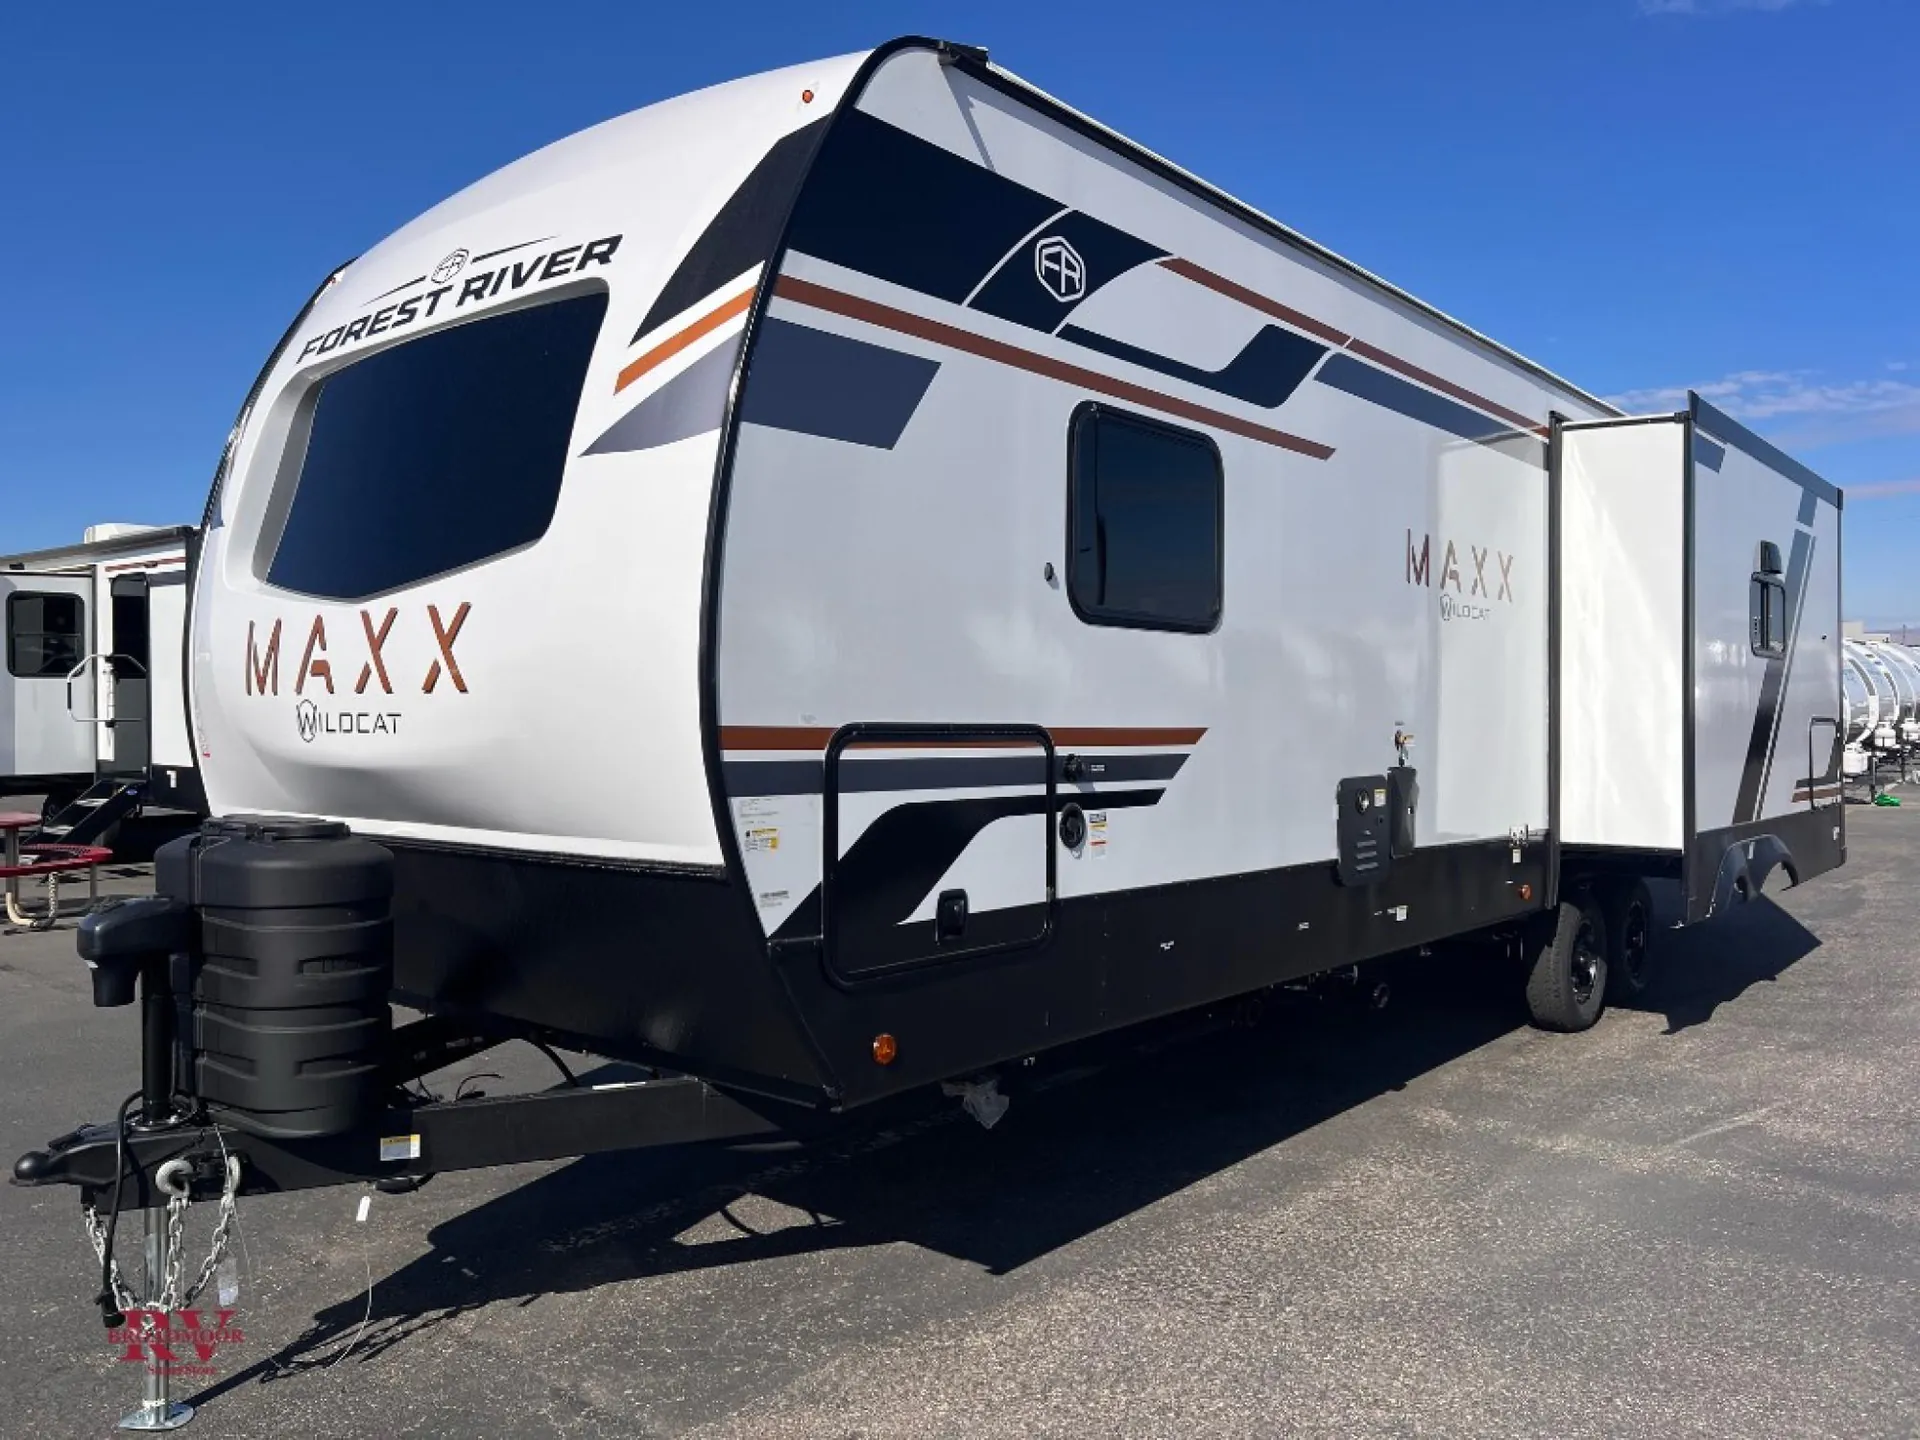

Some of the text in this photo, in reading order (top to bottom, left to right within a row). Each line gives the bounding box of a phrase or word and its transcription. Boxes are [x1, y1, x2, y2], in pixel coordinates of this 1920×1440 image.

[296, 233, 623, 364] FOREST RIVER
[1406, 528, 1513, 603] MAXX
[1440, 594, 1491, 621] WILDCAT
[244, 601, 472, 695] MAXX
[296, 698, 402, 742] WILDCAT
